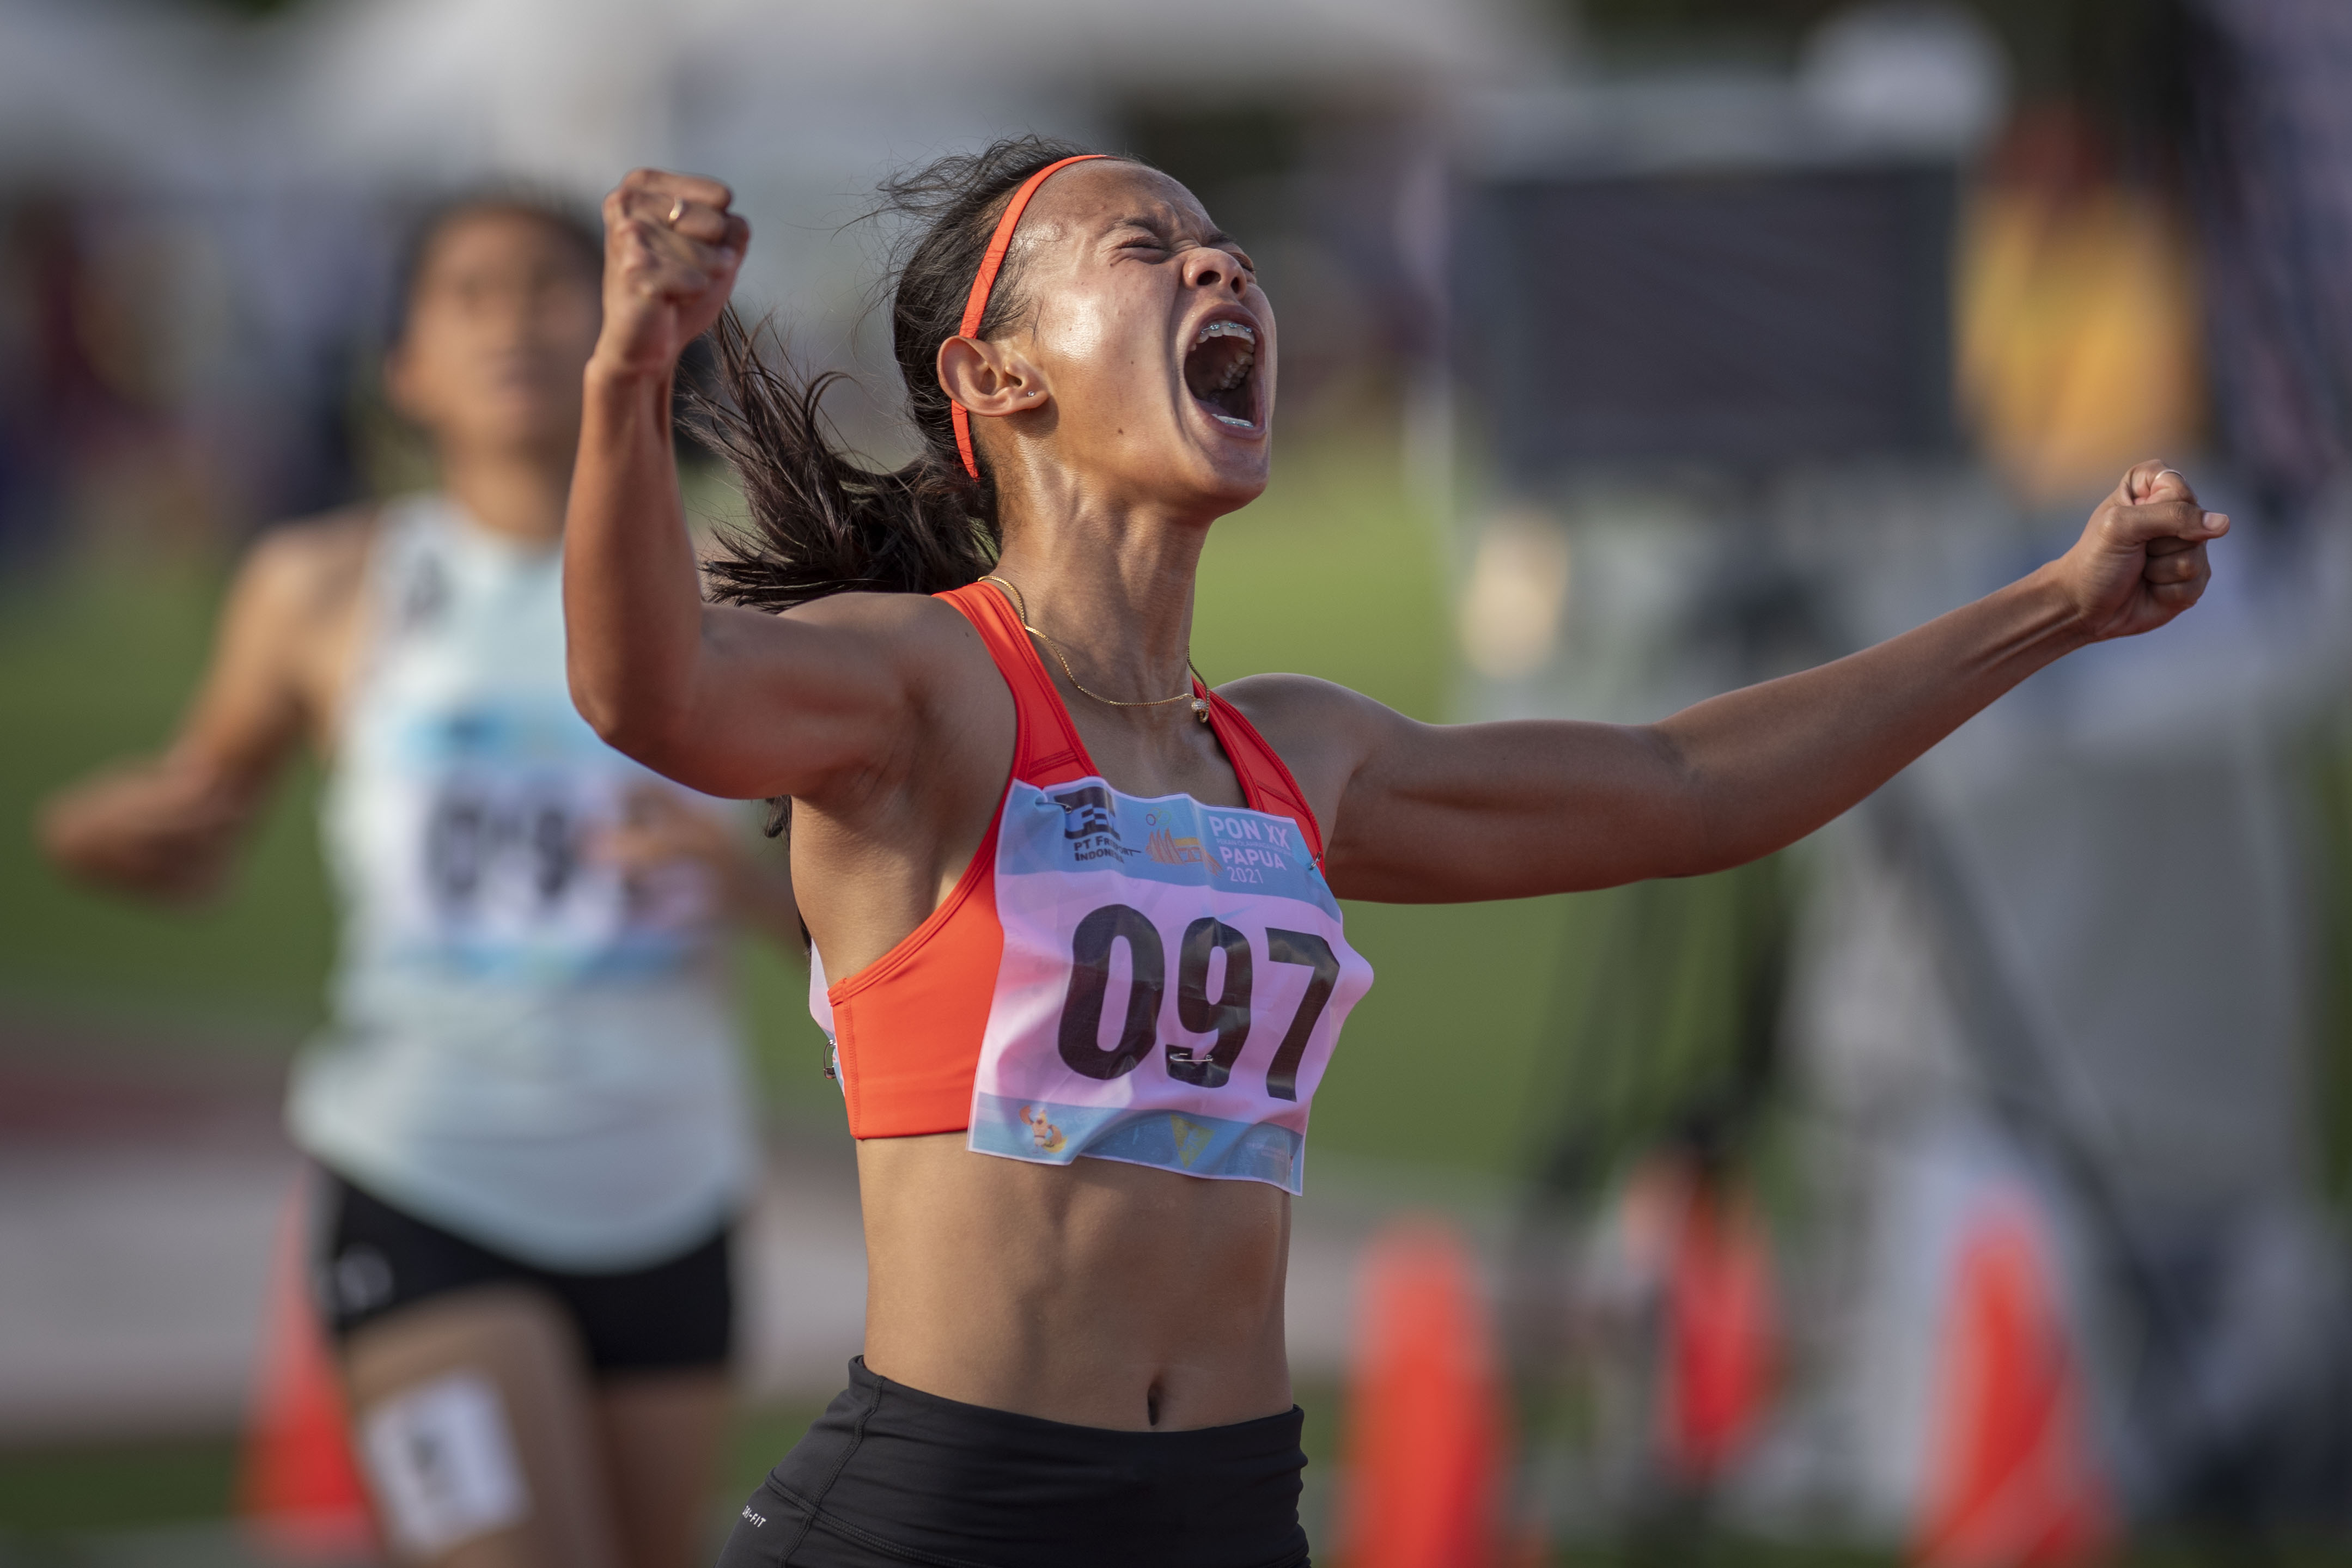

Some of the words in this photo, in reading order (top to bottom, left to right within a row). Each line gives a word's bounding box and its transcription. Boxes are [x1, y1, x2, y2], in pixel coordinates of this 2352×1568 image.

[1074, 839, 1090, 851] PT
[1208, 816, 1262, 840] PON
[1263, 822, 1290, 850] XX
[1219, 846, 1287, 870] PAPUA
[1226, 866, 1263, 884] 2021
[1058, 904, 1340, 1102] 097
